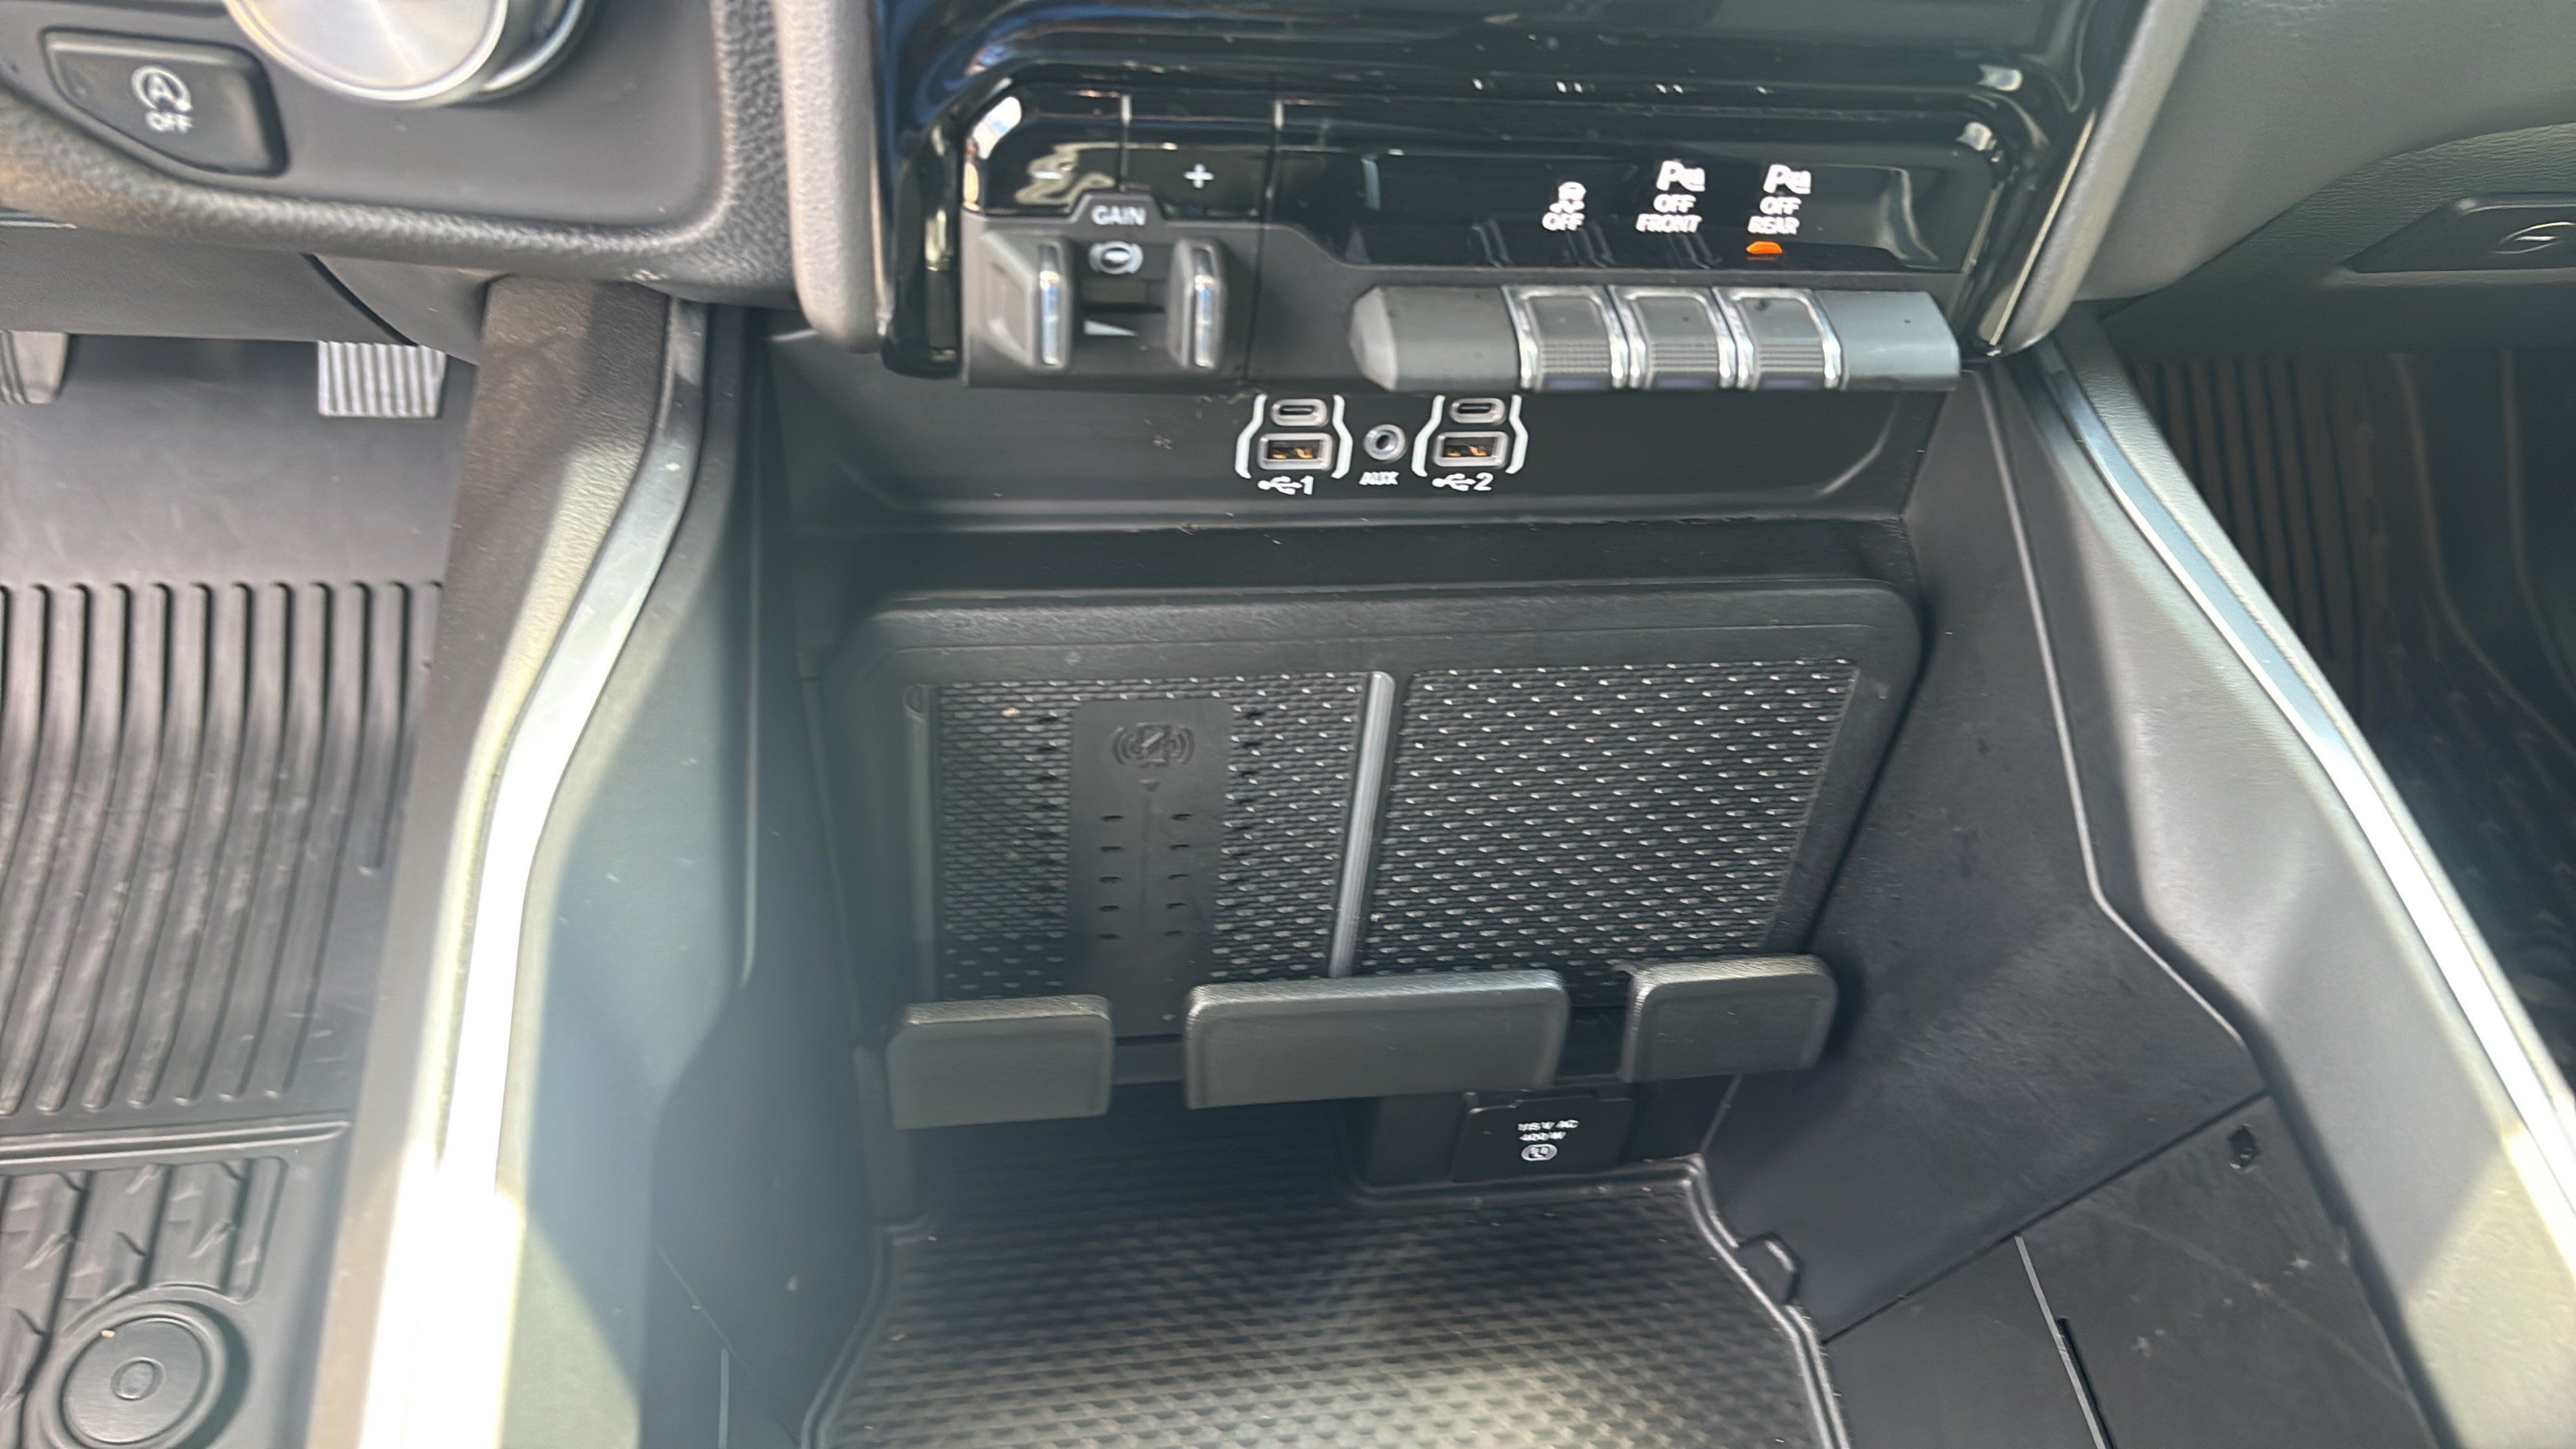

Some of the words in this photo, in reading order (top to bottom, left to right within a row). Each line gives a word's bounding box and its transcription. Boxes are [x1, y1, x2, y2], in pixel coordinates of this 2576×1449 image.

[145, 112, 193, 133] OFF
[1654, 194, 1697, 213] OFF
[1760, 197, 1802, 215] OFF
[1091, 205, 1146, 225] GAIN
[1542, 211, 1585, 231] OFF
[1636, 214, 1702, 233] FRONT
[1359, 472, 1399, 486] AUX
[1473, 472, 1494, 491] 2
[1555, 1119, 1579, 1128] AC
